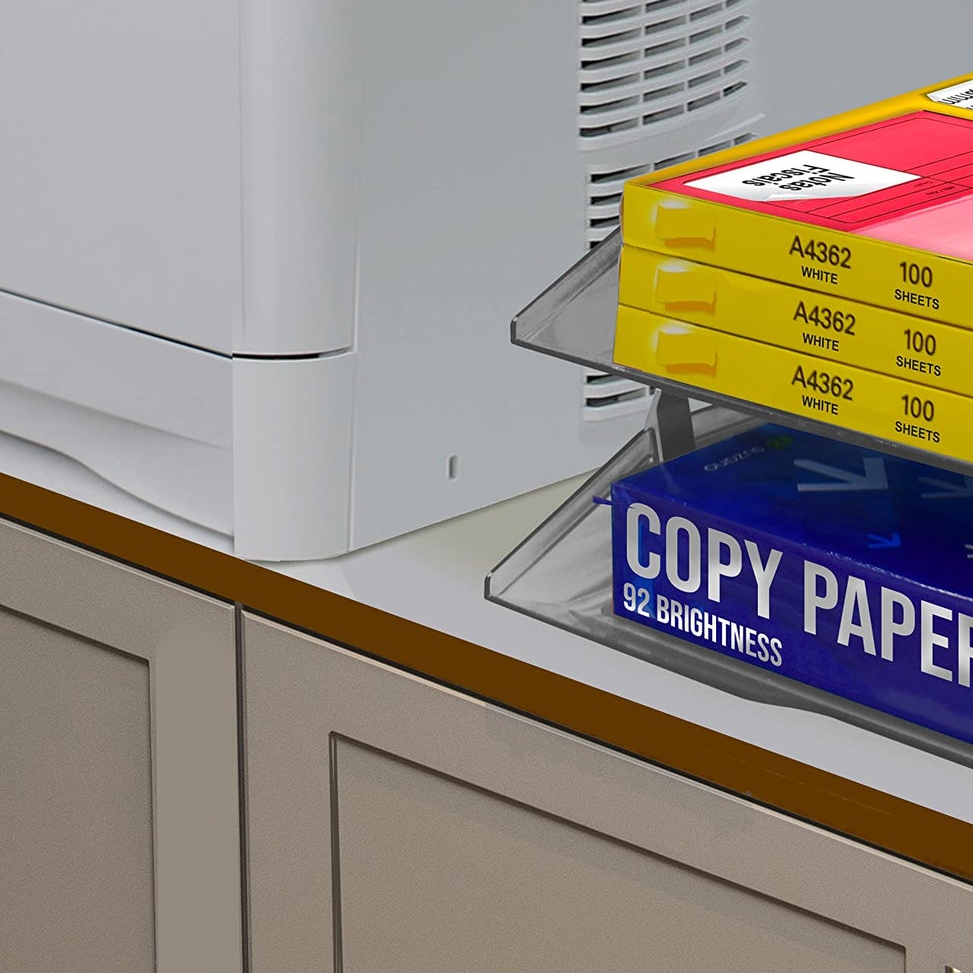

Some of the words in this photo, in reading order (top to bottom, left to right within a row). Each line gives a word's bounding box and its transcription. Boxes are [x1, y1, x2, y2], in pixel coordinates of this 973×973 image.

[742, 165, 827, 186] Fiscais
[779, 173, 853, 191] Notas
[789, 235, 851, 269] A4362
[900, 261, 932, 287] 100
[801, 266, 838, 285] WHITE
[894, 289, 940, 309] SHEETS
[793, 301, 856, 335] A4362
[904, 329, 936, 356] 100
[802, 333, 840, 352] WHITE
[896, 355, 941, 377] SHEETS
[792, 365, 854, 401] A4362
[901, 395, 934, 421] 100
[802, 395, 838, 415] WHITE
[895, 421, 940, 443] SHEETS
[626, 502, 783, 619] COPY
[623, 582, 650, 618] 92
[656, 593, 782, 667] BRIGHTNESS
